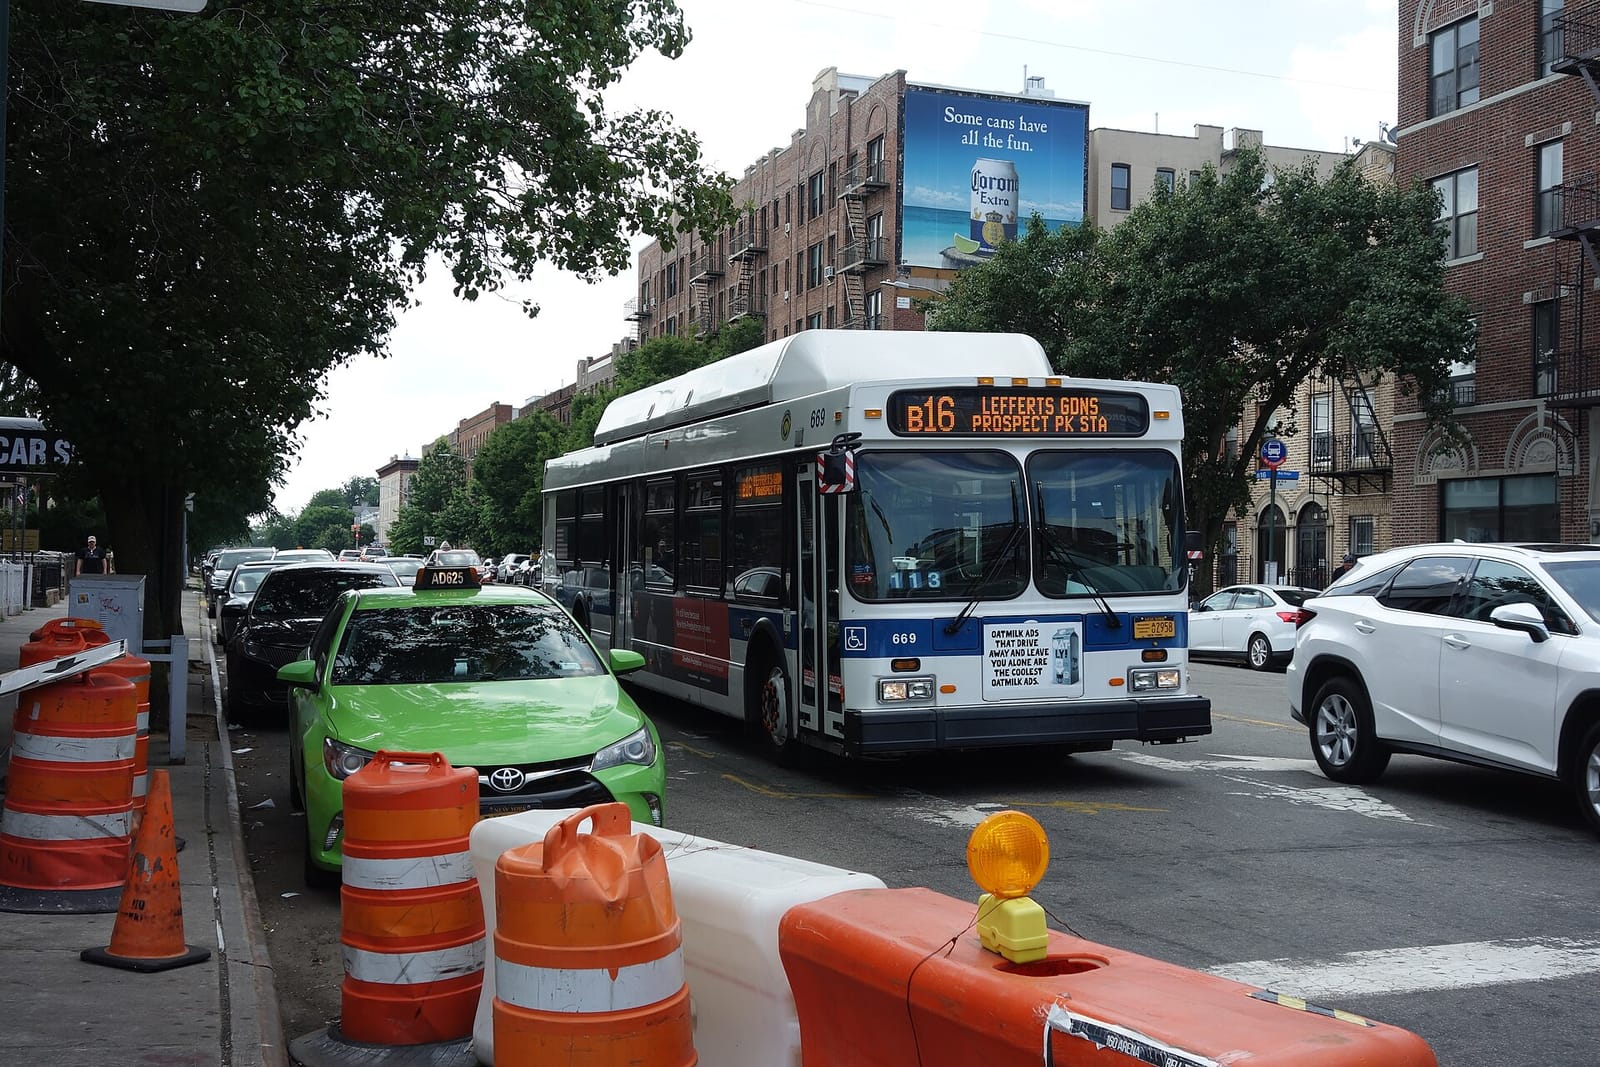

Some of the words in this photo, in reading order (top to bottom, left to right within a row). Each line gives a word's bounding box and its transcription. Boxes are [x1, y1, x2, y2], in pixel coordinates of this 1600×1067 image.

[944, 106, 983, 126] Some
[986, 117, 1015, 130] cans
[1019, 115, 1048, 133] have
[961, 130, 979, 146] all
[983, 132, 1003, 148] the
[1007, 134, 1033, 152] fun.
[980, 191, 1009, 207] Extra
[982, 397, 1054, 415] LEFFERTS
[810, 407, 826, 429] 669
[907, 396, 955, 432] B16
[972, 415, 1048, 432] PROSPECT
[1055, 416, 1075, 432] PK
[1080, 416, 1108, 432] STA
[0, 436, 46, 465] CAR
[431, 571, 464, 585] AD625
[892, 633, 917, 644] 669
[991, 630, 1023, 638] OATMILK
[1025, 629, 1039, 637] ADS
[995, 640, 1015, 648] THAT
[1017, 639, 1038, 647] DRIVE
[989, 649, 1010, 658] AWAY
[1010, 649, 1025, 657] AND
[1027, 648, 1049, 656] LEAVE
[1055, 649, 1068, 658] LY!
[991, 659, 1006, 667] YOU
[1008, 658, 1032, 667] ALONE
[1033, 658, 1048, 666] ARE
[994, 668, 1010, 677] THE
[1011, 667, 1043, 676] COOLEST
[991, 678, 1023, 687] OATMILK
[1023, 677, 1039, 686] ADS.
[1106, 1034, 1119, 1049] 160
[1117, 1039, 1140, 1059] ARENA
